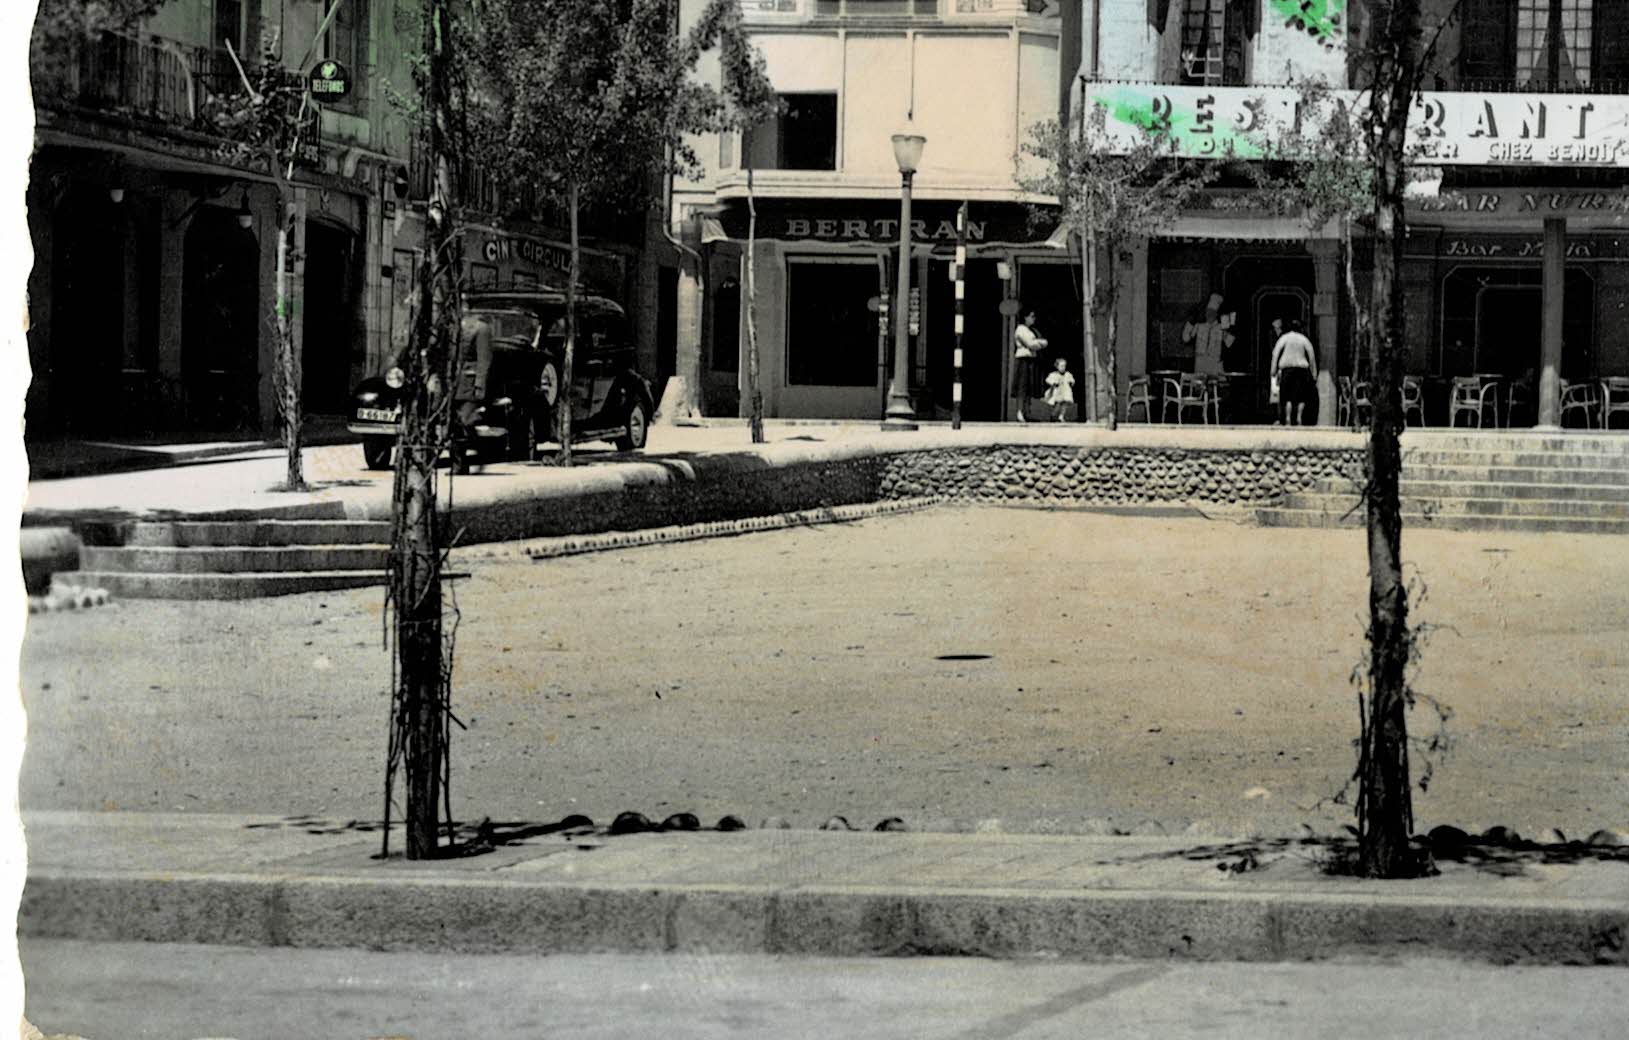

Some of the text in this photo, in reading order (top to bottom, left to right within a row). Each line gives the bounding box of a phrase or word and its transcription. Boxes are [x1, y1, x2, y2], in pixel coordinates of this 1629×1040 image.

[1488, 142, 1532, 161] CHEZ
[786, 218, 988, 240] BERTRAN
[1446, 240, 1502, 257] Bar
